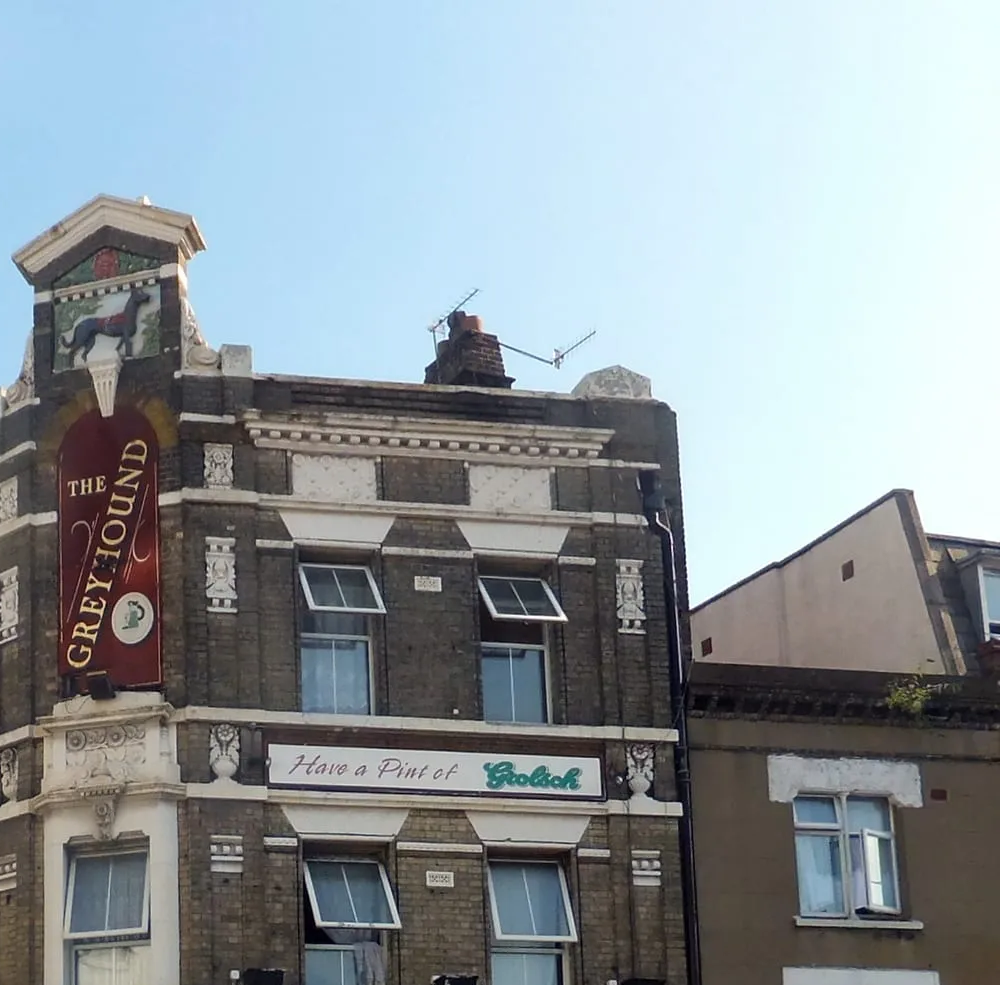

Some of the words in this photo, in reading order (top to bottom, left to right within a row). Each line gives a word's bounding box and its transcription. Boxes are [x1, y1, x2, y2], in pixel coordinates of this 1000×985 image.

[67, 475, 107, 497] THE
[66, 438, 149, 669] GREYHOUND
[289, 753, 348, 776] Have
[354, 763, 368, 777] a
[377, 757, 429, 780] Pint
[432, 764, 458, 780] of
[483, 760, 583, 790] Grolsch
